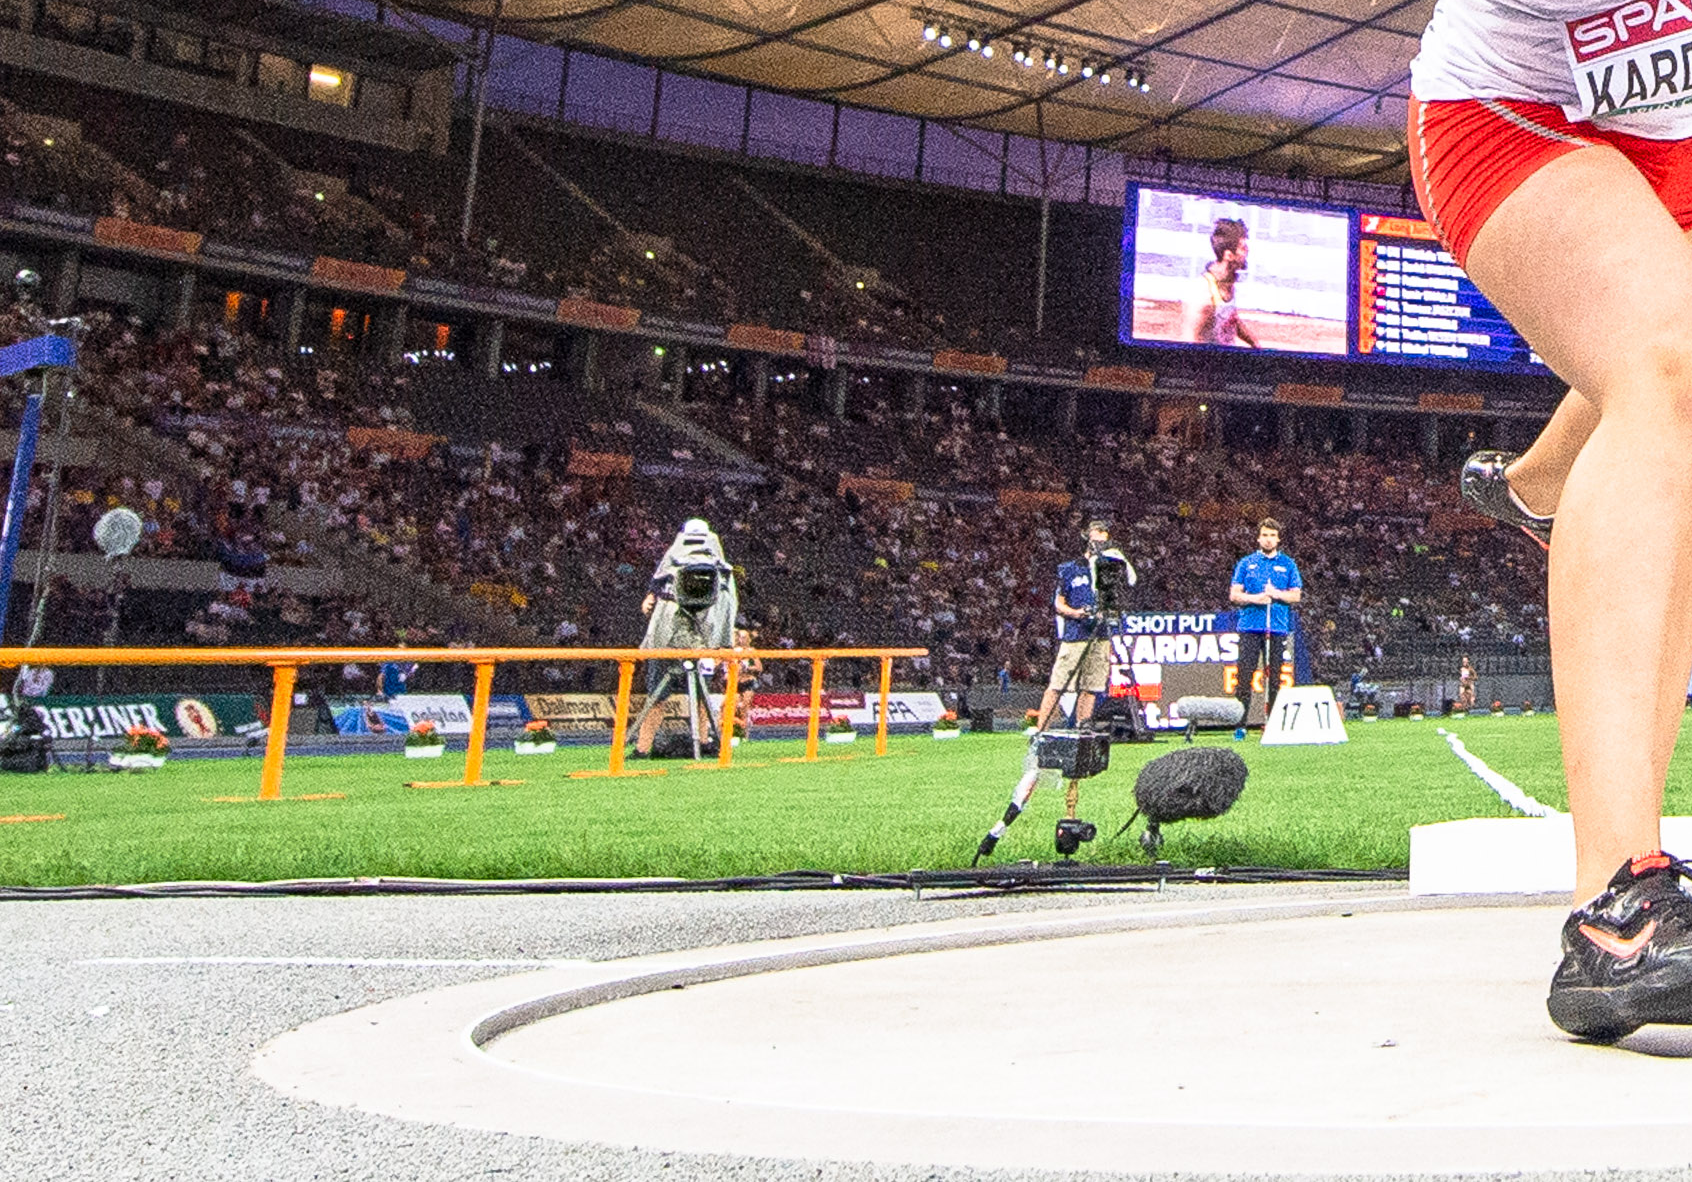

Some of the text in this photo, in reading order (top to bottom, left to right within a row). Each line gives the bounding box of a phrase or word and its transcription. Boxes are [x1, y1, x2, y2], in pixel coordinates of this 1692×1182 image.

[1126, 614, 1216, 633] SHOT PUT
[536, 697, 602, 718] Dallmayr
[1281, 700, 1331, 731] 17 17
